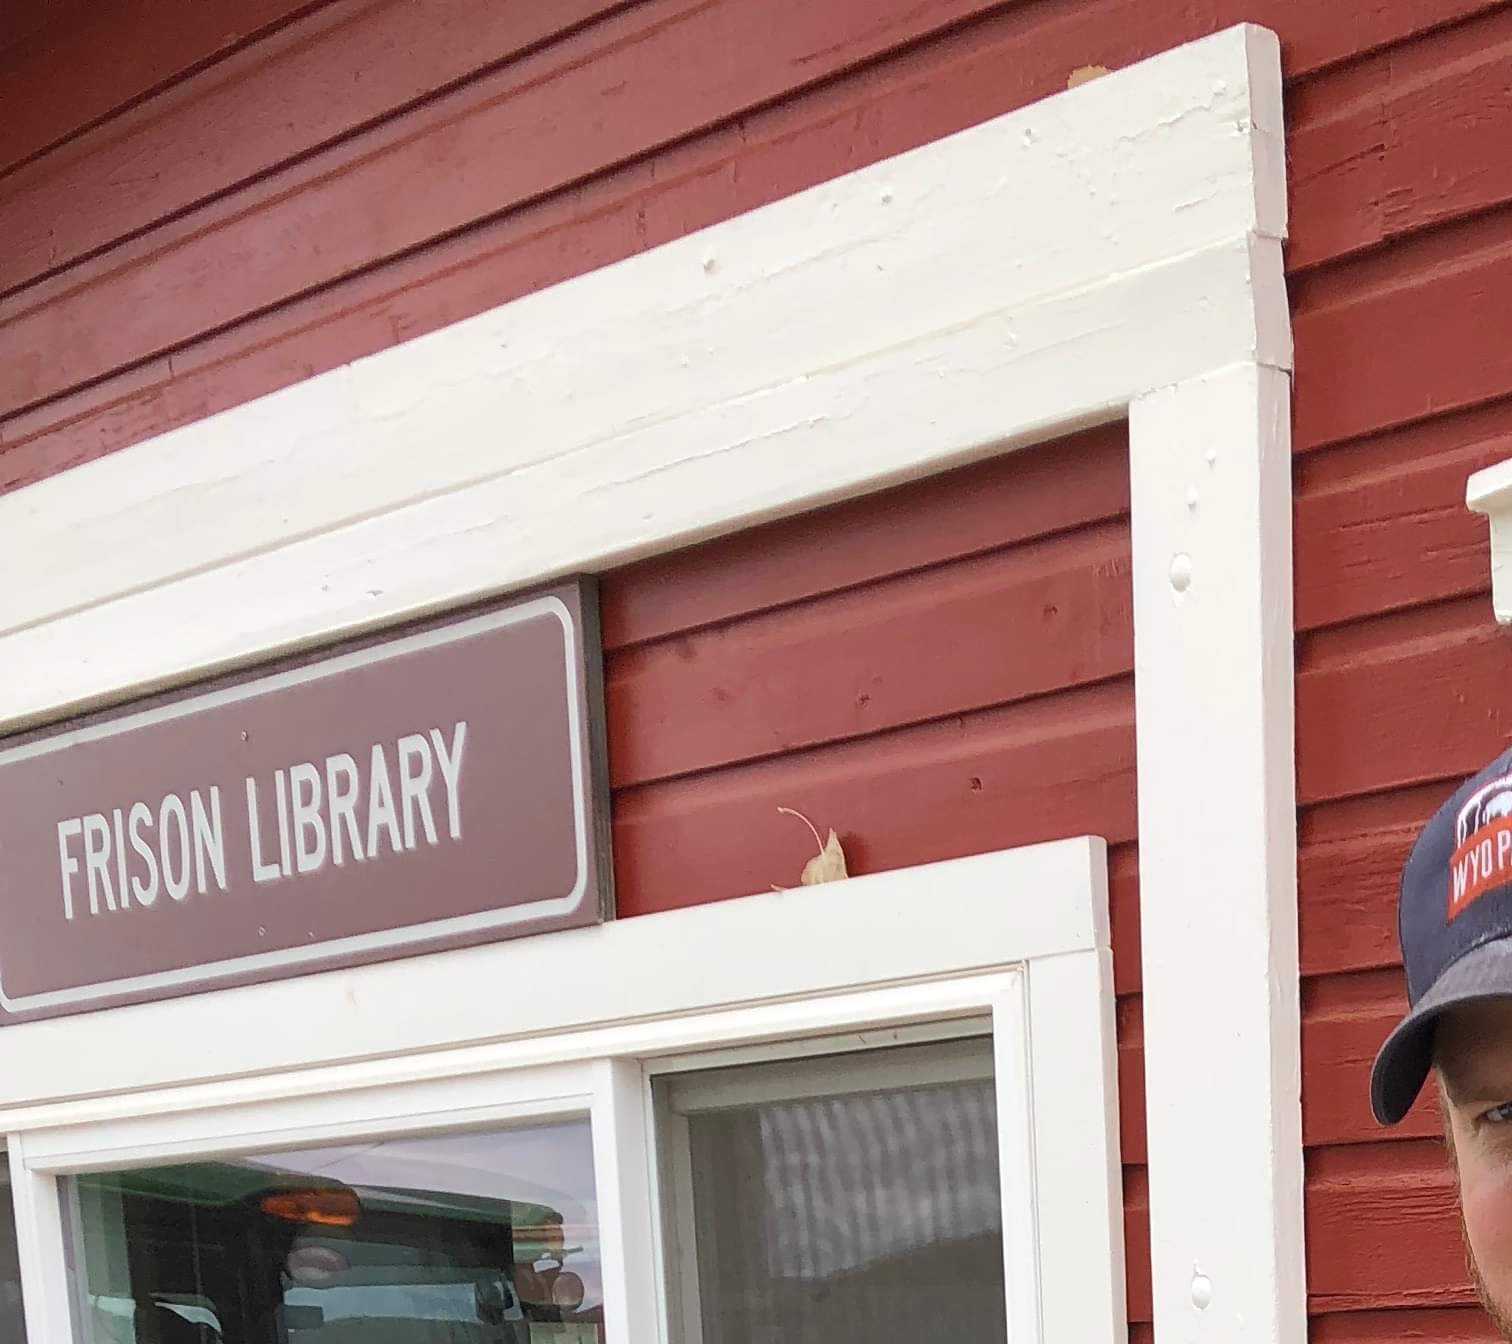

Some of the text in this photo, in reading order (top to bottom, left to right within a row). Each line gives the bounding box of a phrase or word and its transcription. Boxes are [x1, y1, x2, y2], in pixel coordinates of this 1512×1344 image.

[58, 721, 466, 919] FRISON LIBRARY
[1453, 840, 1492, 904] WYO
